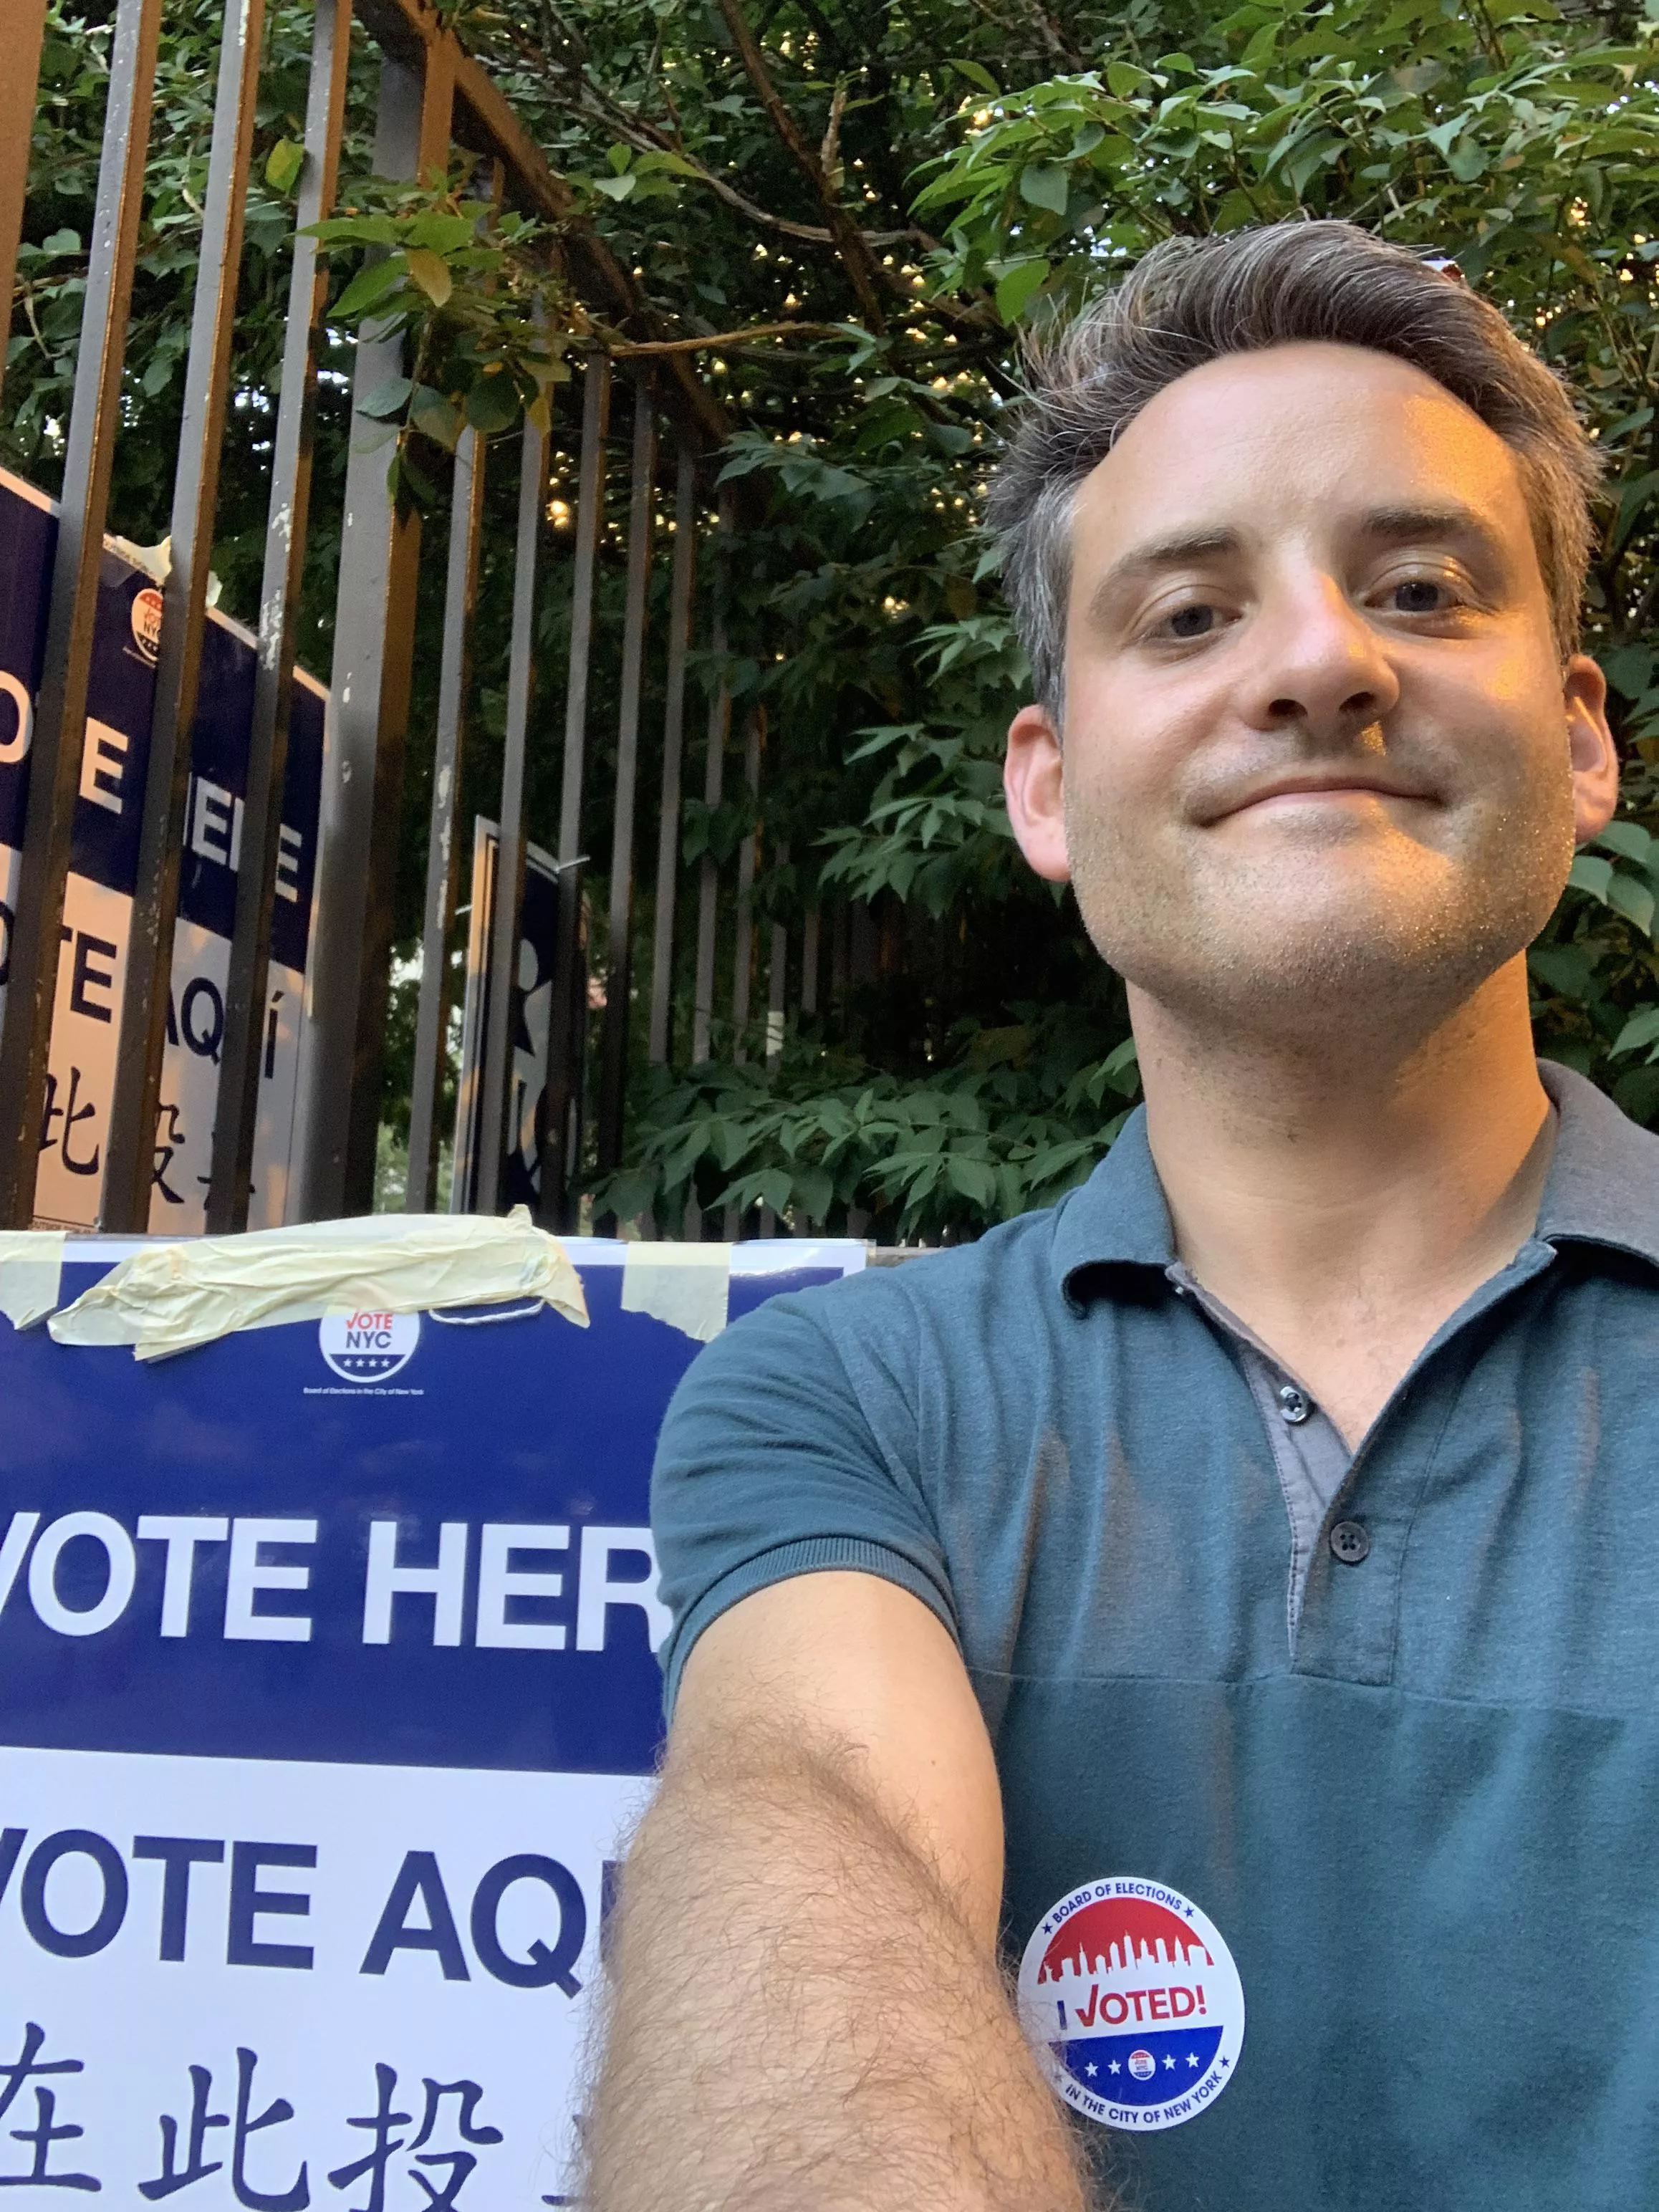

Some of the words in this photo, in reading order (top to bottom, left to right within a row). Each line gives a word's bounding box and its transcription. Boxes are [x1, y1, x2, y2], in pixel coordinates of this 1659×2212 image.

[345, 1331, 392, 1350] NYC
[360, 1850, 622, 1999] AQ
[1052, 1890, 1092, 1923] BOARD
[1095, 1884, 1111, 1898] OF
[1115, 1882, 1182, 1910] ELECTIONS
[1057, 2000, 1067, 2030] I
[1074, 1983, 1207, 2027] VOTED!
[0, 2021, 595, 2212] 在此投
[1066, 2084, 1080, 2100] IN
[1082, 2095, 1105, 2115] THE
[1108, 2107, 1139, 2123] CITY
[1143, 2111, 1160, 2124] OF
[1163, 2099, 1192, 2120] NEW
[1191, 2071, 1223, 2104] YORK
